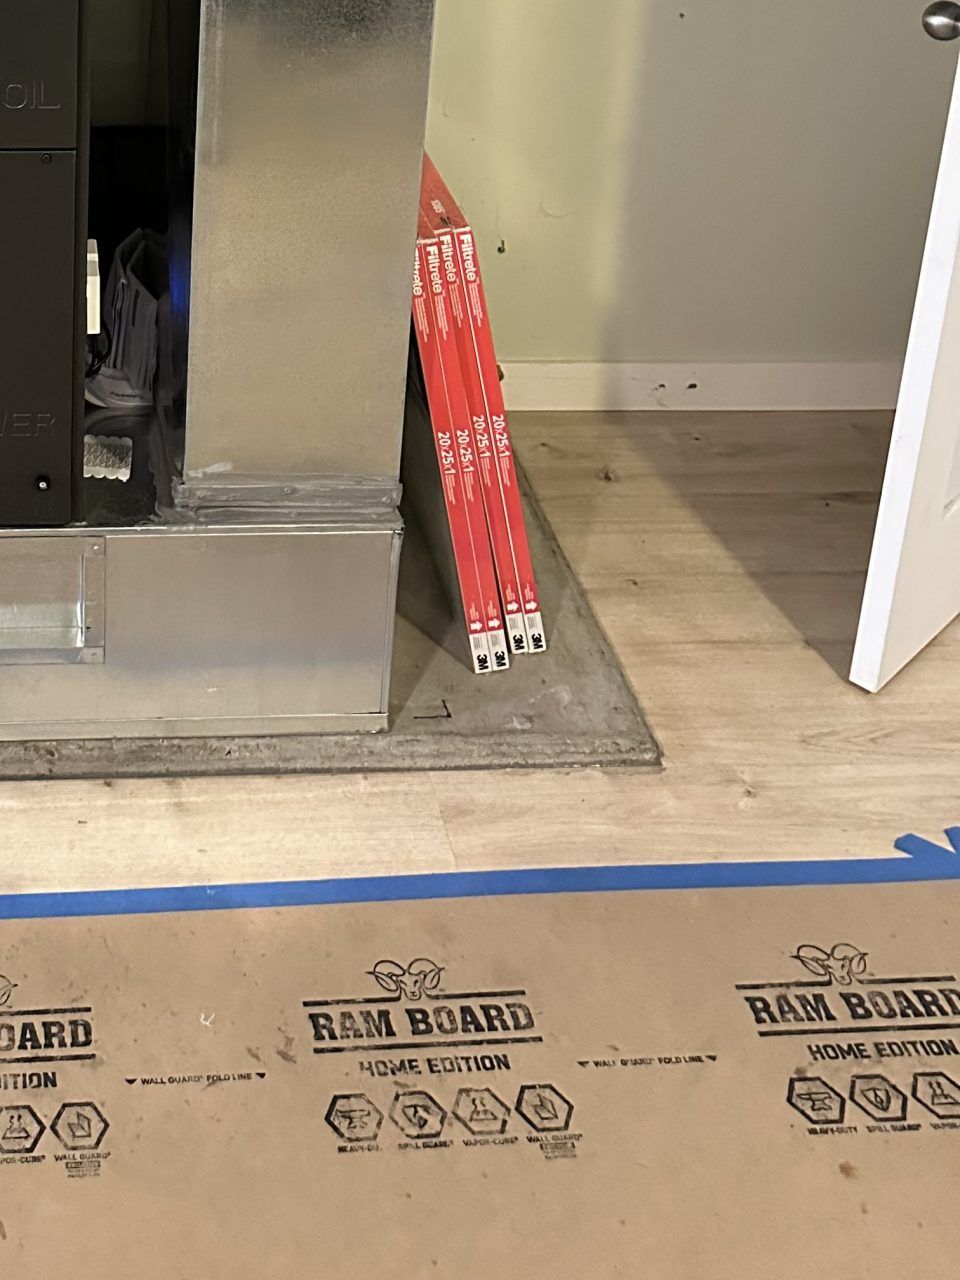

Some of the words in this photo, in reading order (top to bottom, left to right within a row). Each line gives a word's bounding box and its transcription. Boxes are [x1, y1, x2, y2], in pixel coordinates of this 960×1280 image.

[439, 234, 457, 282] Filtrete
[459, 233, 477, 281] Filtrete
[426, 245, 443, 294] Filtrete
[472, 414, 491, 457] 20x25x1
[492, 414, 511, 457] 20x25x1
[438, 431, 456, 474] 20x25x1
[456, 429, 475, 472] 20x25x1
[512, 634, 525, 650] 3M
[531, 633, 543, 650] 3M
[477, 654, 489, 671] 3M
[494, 651, 507, 667] 3M
[744, 993, 838, 1025] RAM
[838, 988, 960, 1020] BOARD
[308, 1008, 397, 1041] RAM
[404, 1002, 535, 1036] BOARD
[657, 1056, 682, 1065] FOLD
[683, 1054, 704, 1064] LINE
[806, 1042, 872, 1062] HOME
[872, 1039, 960, 1058] EDITION
[358, 1058, 422, 1077] HOME
[428, 1054, 512, 1074] EDITION
[141, 1078, 166, 1086] WALL
[205, 1074, 230, 1082] FOLD
[526, 1134, 550, 1144] WALL
[54, 1153, 78, 1162] WALL
